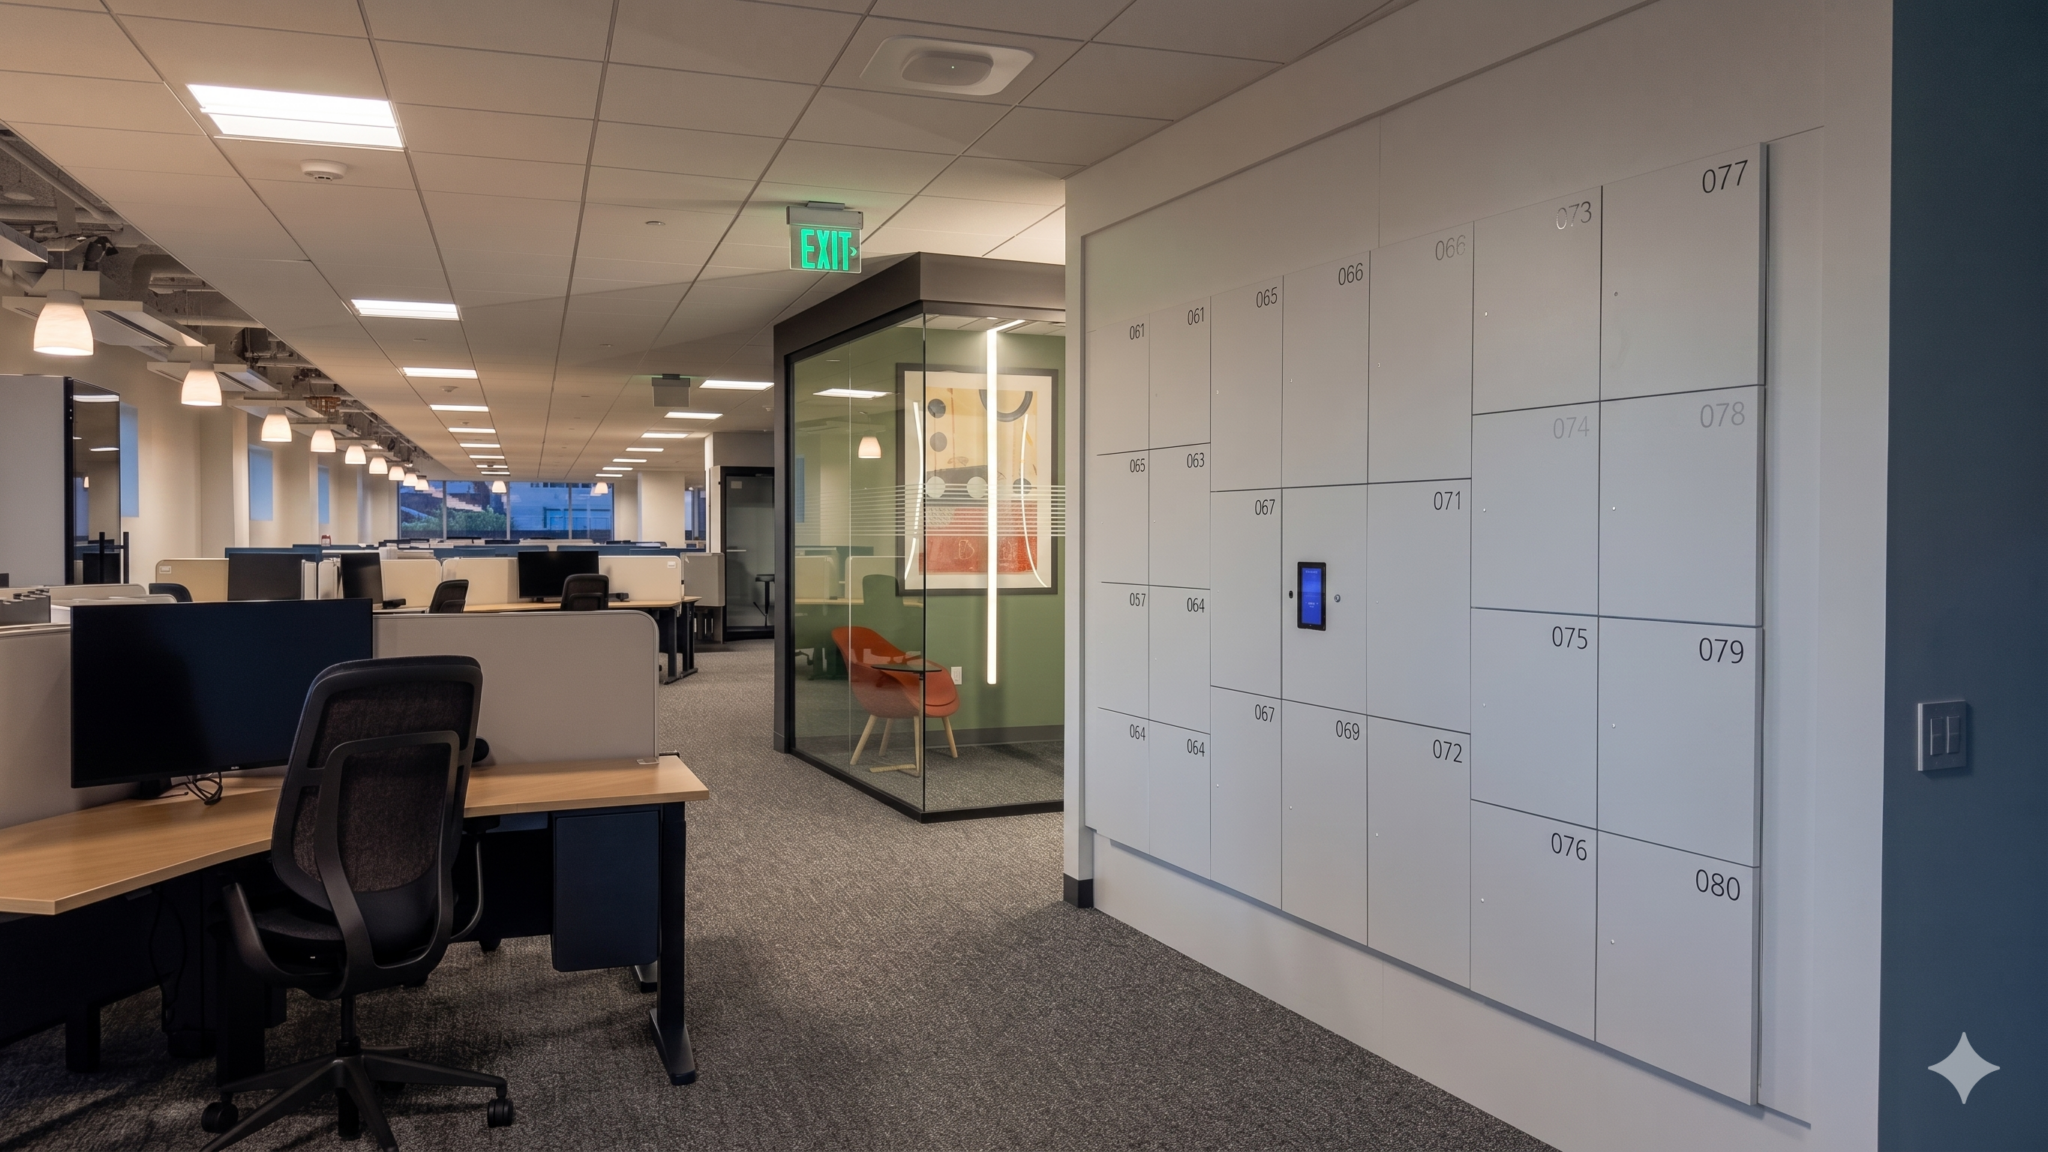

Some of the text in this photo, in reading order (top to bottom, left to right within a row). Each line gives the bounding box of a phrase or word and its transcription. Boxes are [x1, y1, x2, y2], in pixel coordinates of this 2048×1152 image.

[1703, 160, 1748, 193] 077
[1556, 201, 1591, 229] 073
[800, 228, 852, 271] EXIT
[1435, 235, 1466, 260] 066
[1338, 263, 1363, 285] 066
[1256, 287, 1277, 308] 065
[1188, 307, 1204, 325] 061
[1130, 323, 1144, 340] 061
[1700, 402, 1745, 428] 078
[1553, 416, 1589, 439] 074
[1130, 458, 1145, 473] 065
[1187, 452, 1204, 468] 063
[1255, 499, 1275, 515] 067
[1434, 491, 1460, 510] 071
[1130, 593, 1146, 606] 057
[1187, 598, 1205, 613] 064
[1552, 626, 1587, 649] 075
[1699, 638, 1743, 663] 079
[1255, 704, 1274, 722] 067
[1130, 724, 1146, 741] 064
[1336, 720, 1359, 740] 069
[1187, 739, 1206, 758] 064
[1433, 740, 1462, 763] 072
[1552, 833, 1587, 861] 076
[1696, 869, 1740, 901] 080
